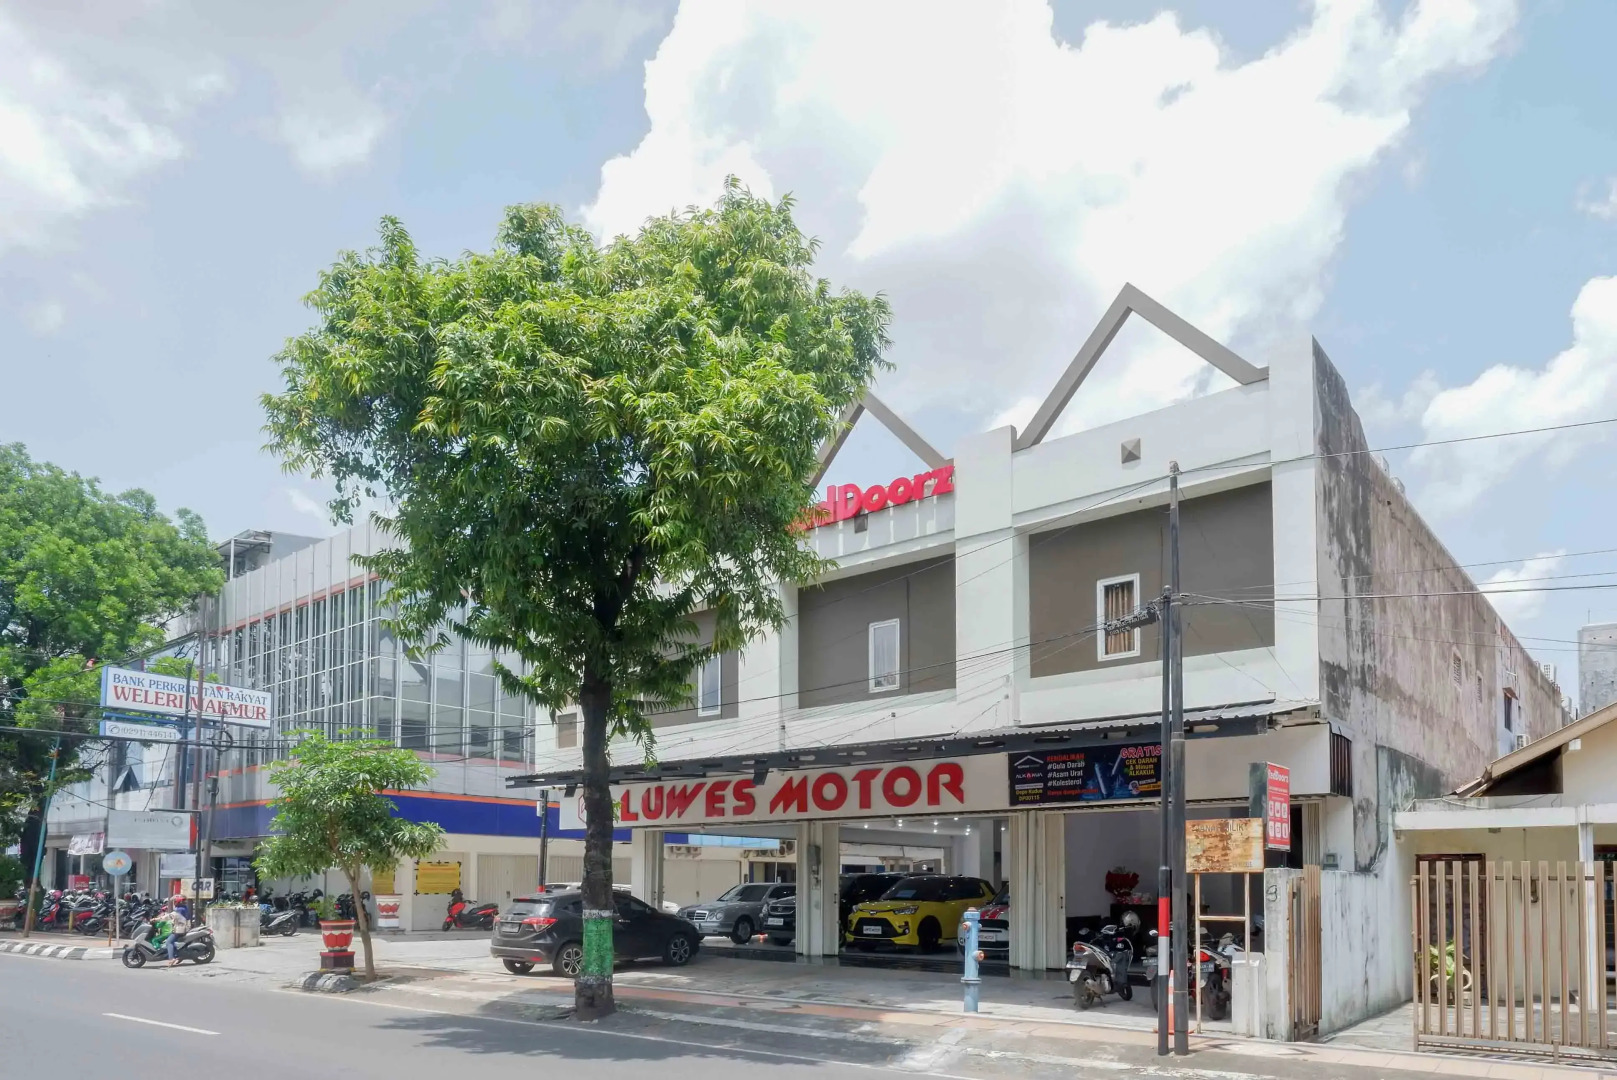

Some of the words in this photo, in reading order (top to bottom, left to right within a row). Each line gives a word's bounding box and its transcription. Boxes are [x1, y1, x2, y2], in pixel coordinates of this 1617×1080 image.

[786, 465, 956, 531] dDoorz
[113, 673, 145, 688] BANK
[227, 691, 267, 706] RAKYAT
[113, 685, 184, 709] WELERI
[1121, 744, 1162, 759] GRATIS
[1066, 760, 1086, 769] Darah
[620, 778, 757, 822] LUWES
[769, 763, 965, 814] MOTOR
[1047, 778, 1082, 787] #Kolesterol
